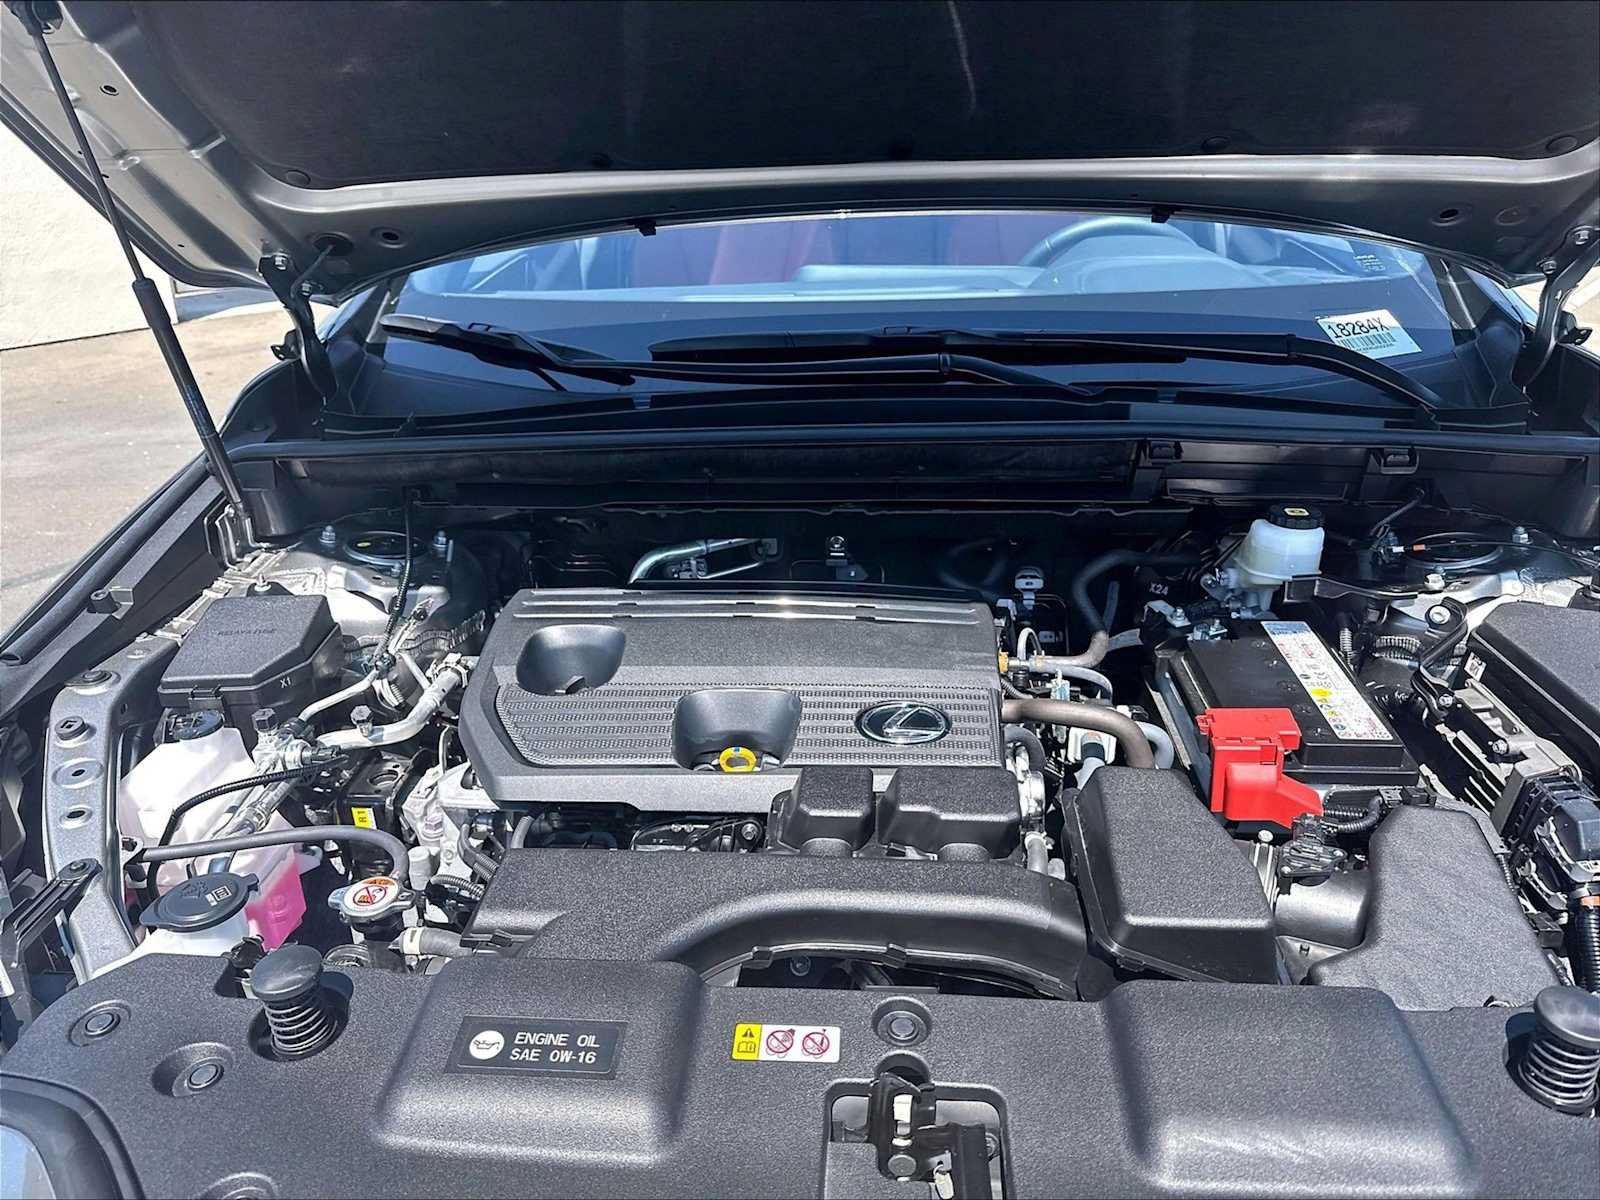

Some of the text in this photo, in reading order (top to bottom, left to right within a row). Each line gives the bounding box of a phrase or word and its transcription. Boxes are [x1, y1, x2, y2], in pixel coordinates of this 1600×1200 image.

[1327, 317, 1390, 339] 18284X
[514, 1031, 601, 1048] ENGINE OIL
[509, 1048, 597, 1064] SAE 0W-16
